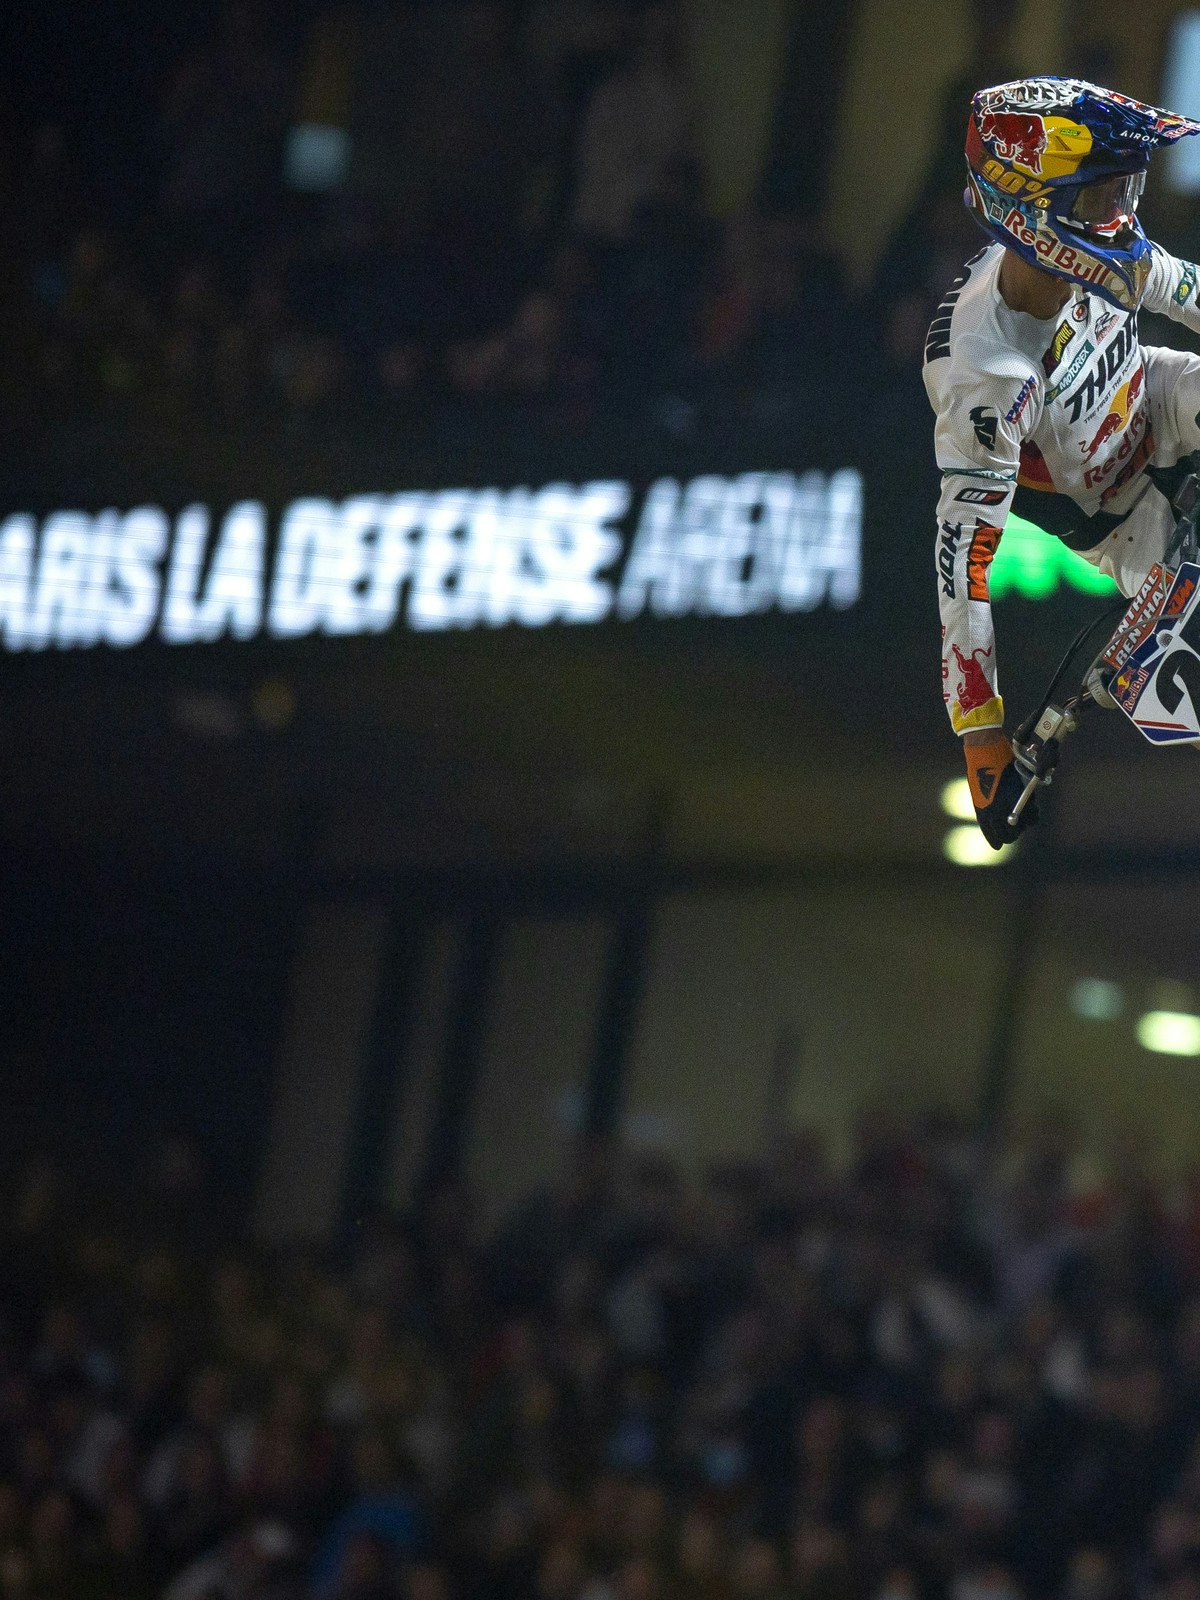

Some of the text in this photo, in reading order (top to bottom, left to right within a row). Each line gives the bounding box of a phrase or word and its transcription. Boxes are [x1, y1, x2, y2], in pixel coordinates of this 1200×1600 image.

[1120, 130, 1160, 144] AIROH
[1059, 346, 1091, 391] MOTOREX
[158, 498, 268, 646] LA
[266, 478, 632, 642] DEFENSE
[614, 467, 864, 622] ARENA
